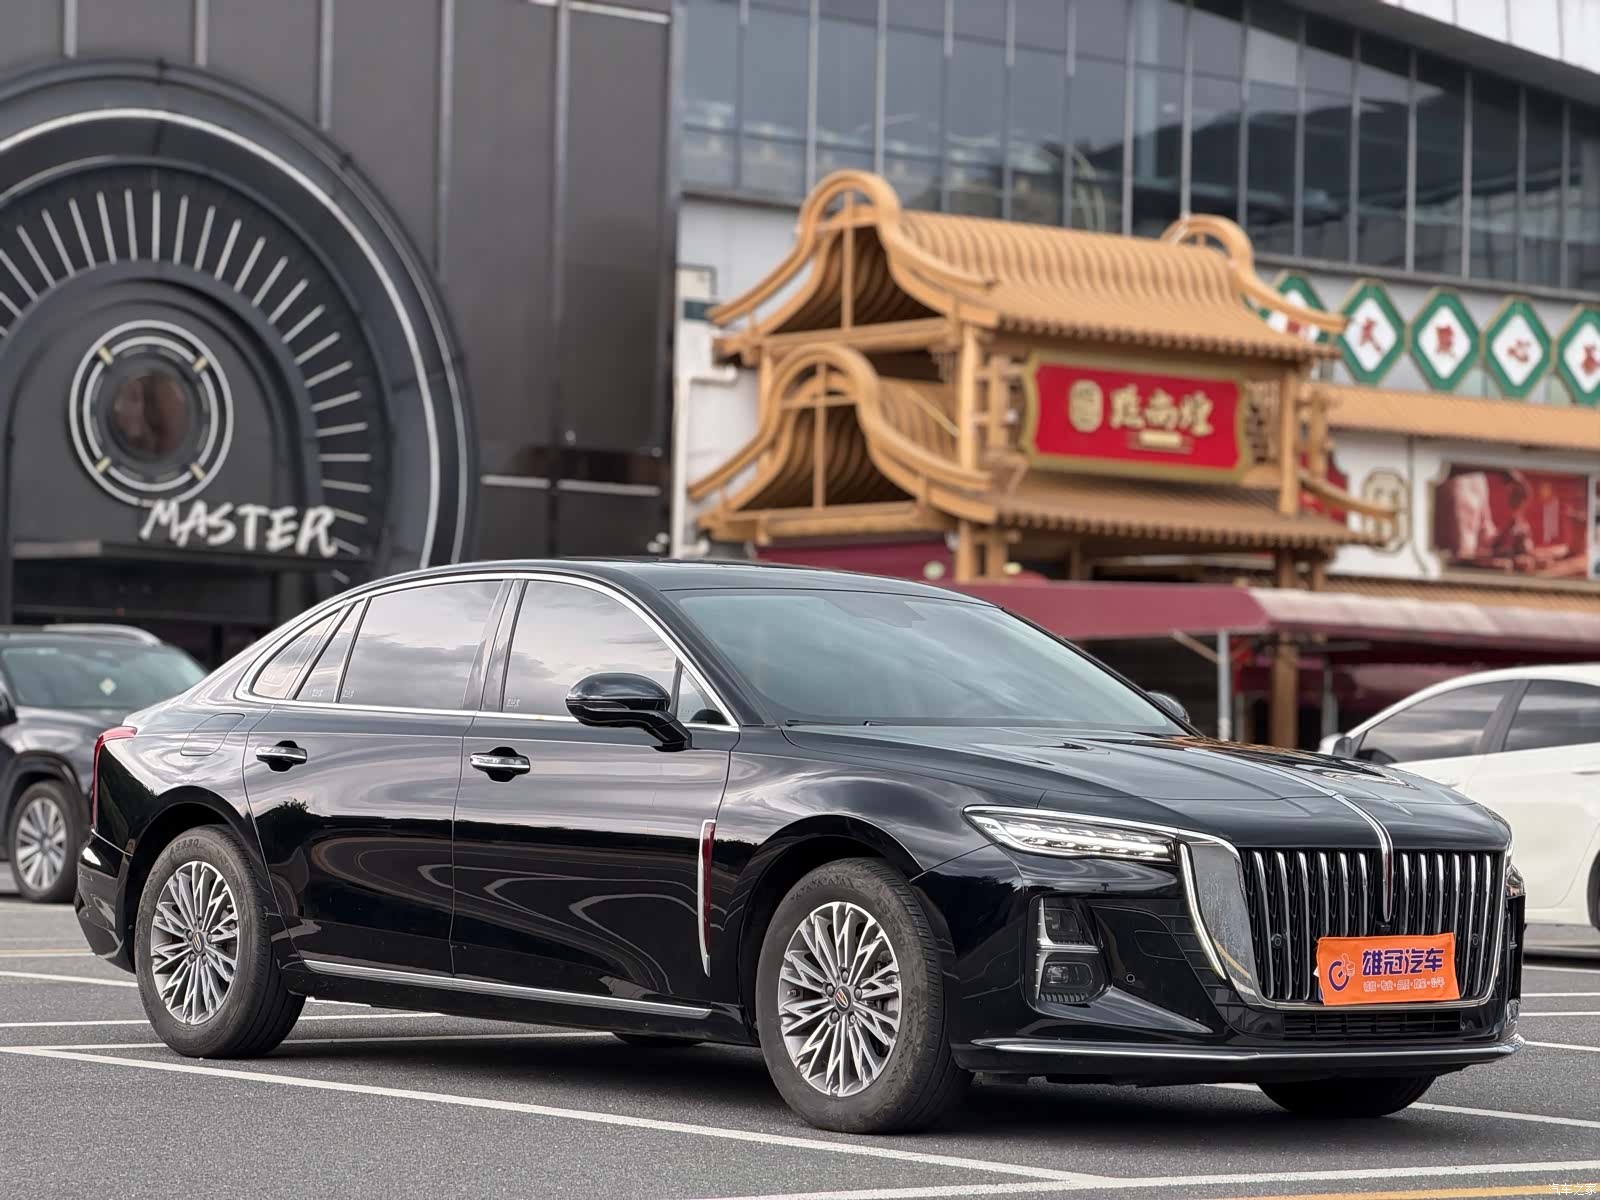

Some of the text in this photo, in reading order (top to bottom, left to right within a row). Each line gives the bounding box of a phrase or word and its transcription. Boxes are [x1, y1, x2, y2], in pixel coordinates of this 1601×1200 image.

[139, 499, 338, 558] MASTER
[1362, 947, 1445, 976] 雄冠汽车
